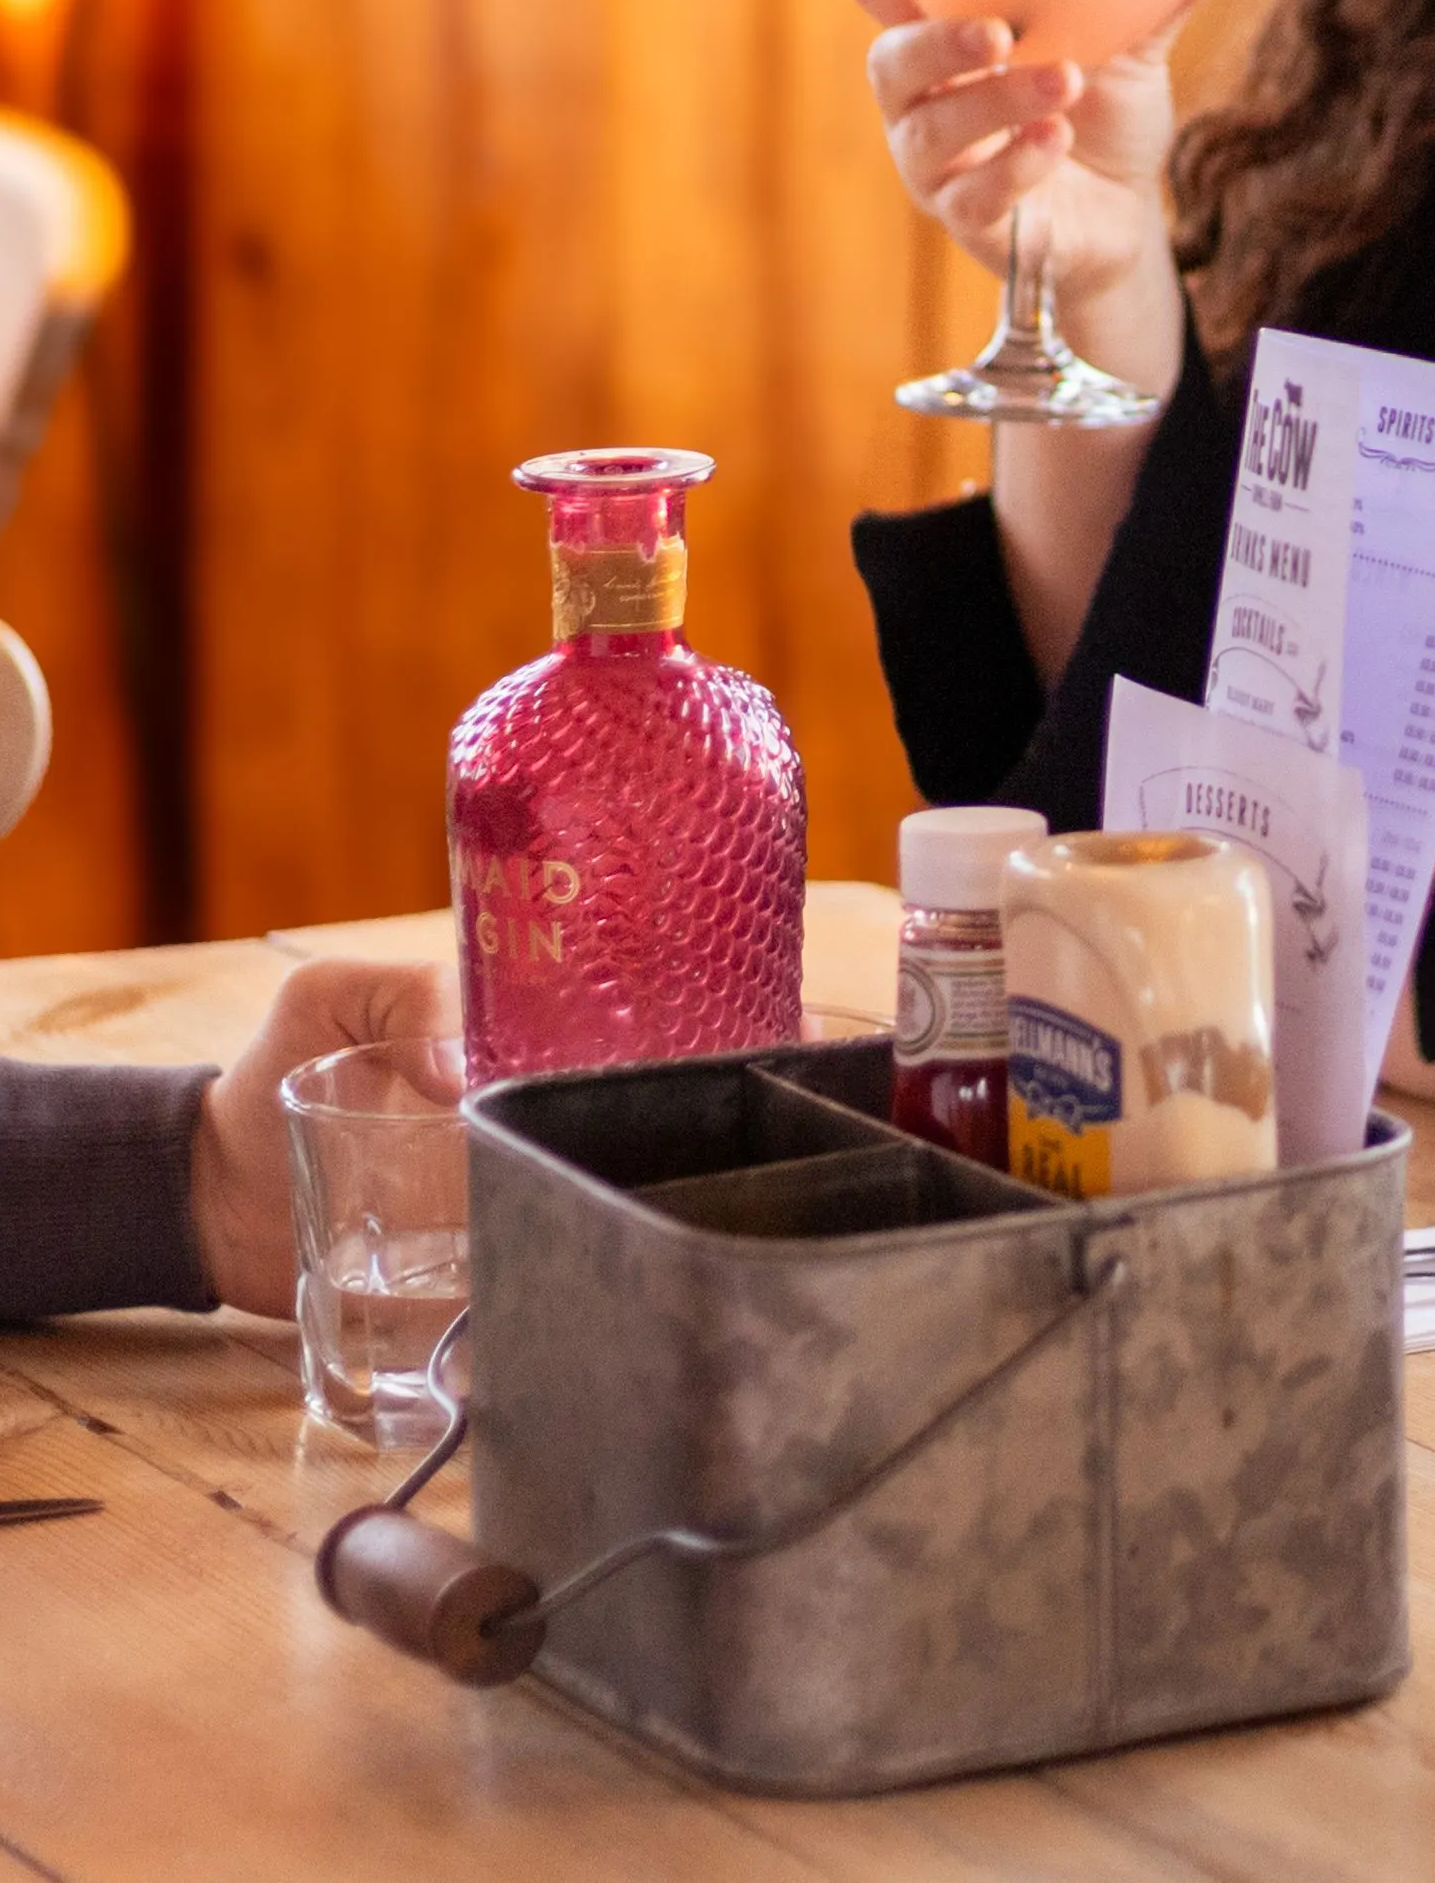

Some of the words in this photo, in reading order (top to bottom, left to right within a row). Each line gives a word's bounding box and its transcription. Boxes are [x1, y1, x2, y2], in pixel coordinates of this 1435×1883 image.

[1267, 398, 1318, 491] COW
[1377, 406, 1435, 444] SPIRITS
[1269, 539, 1311, 588] MENU
[1232, 606, 1285, 656] COCKTAILS
[1186, 783, 1270, 837] DESSERTS
[476, 911, 563, 964] GIN
